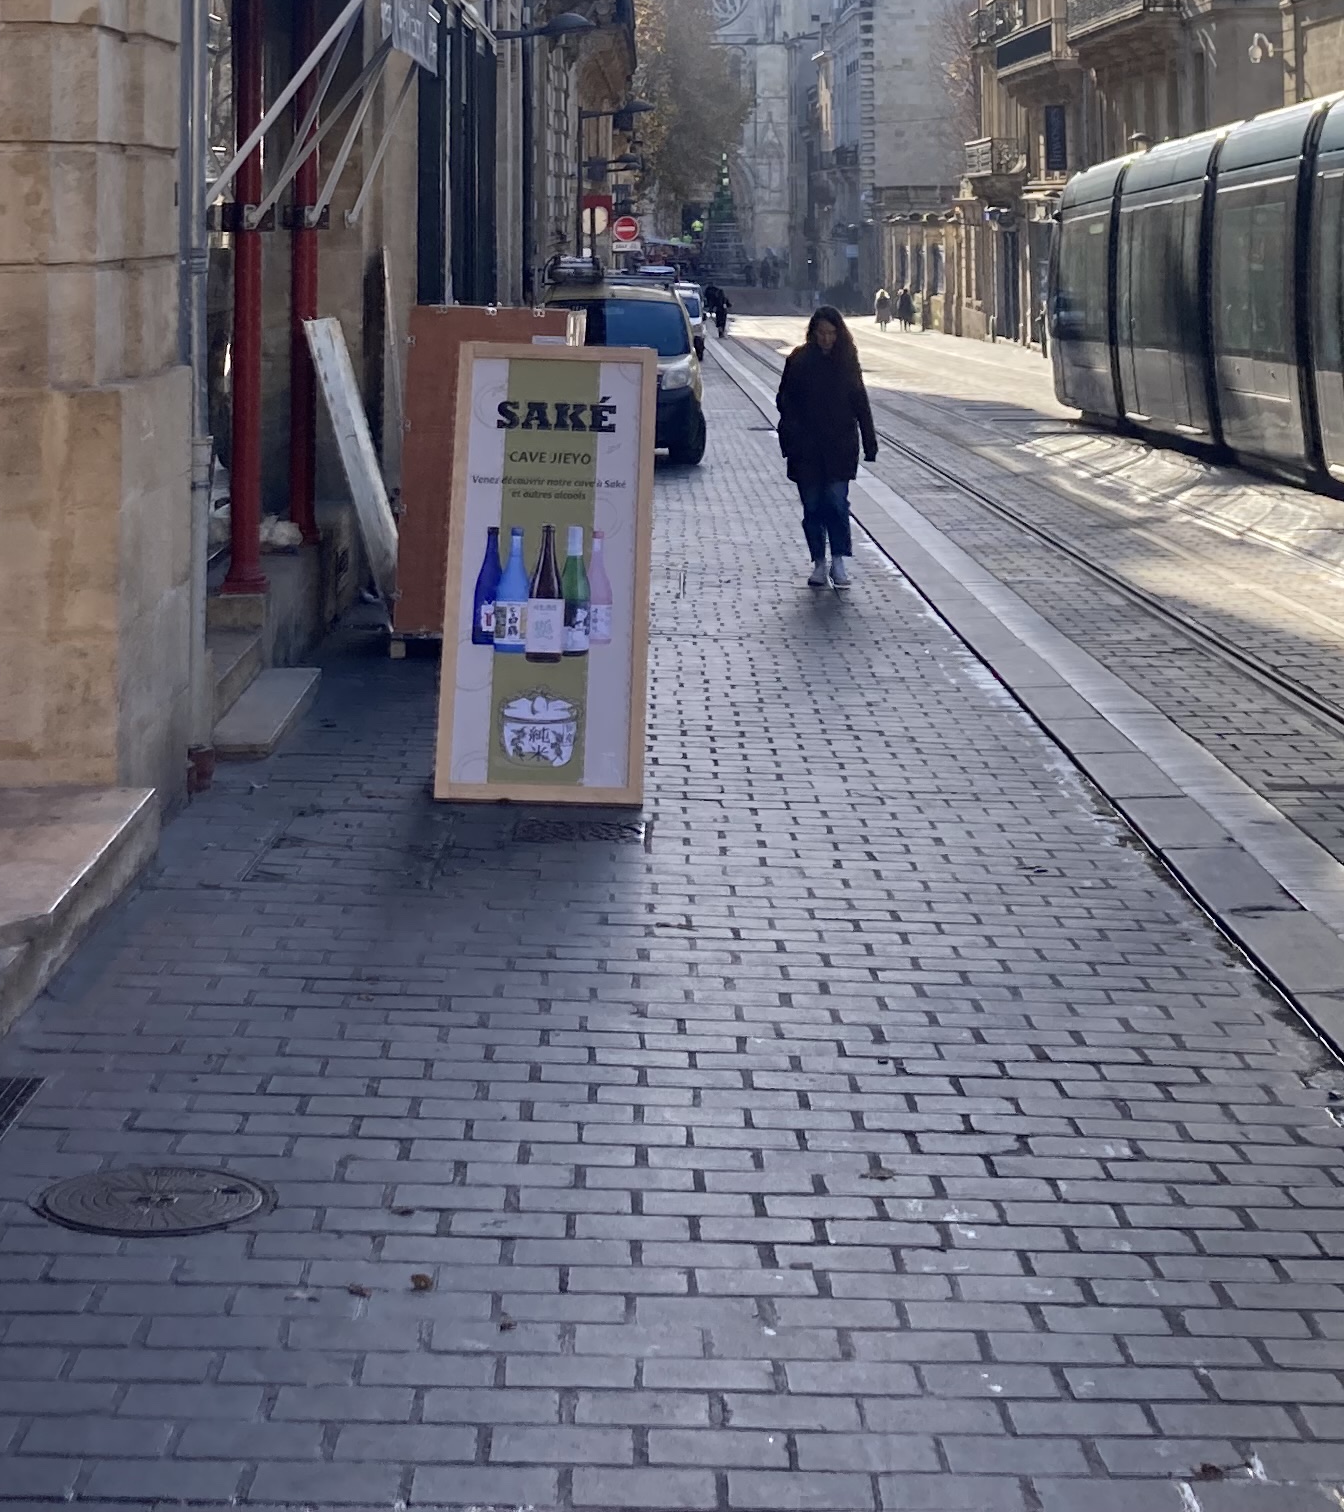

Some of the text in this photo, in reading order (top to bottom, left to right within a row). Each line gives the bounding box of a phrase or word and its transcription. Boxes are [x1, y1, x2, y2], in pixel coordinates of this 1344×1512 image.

[496, 396, 617, 433] SAKÉ
[509, 450, 592, 465] CAVE JIEYO
[472, 474, 498, 484] Venez
[501, 474, 545, 486] découvrir
[546, 476, 572, 487] notre
[604, 479, 627, 489] Saké
[511, 490, 586, 500] et autres alcools
